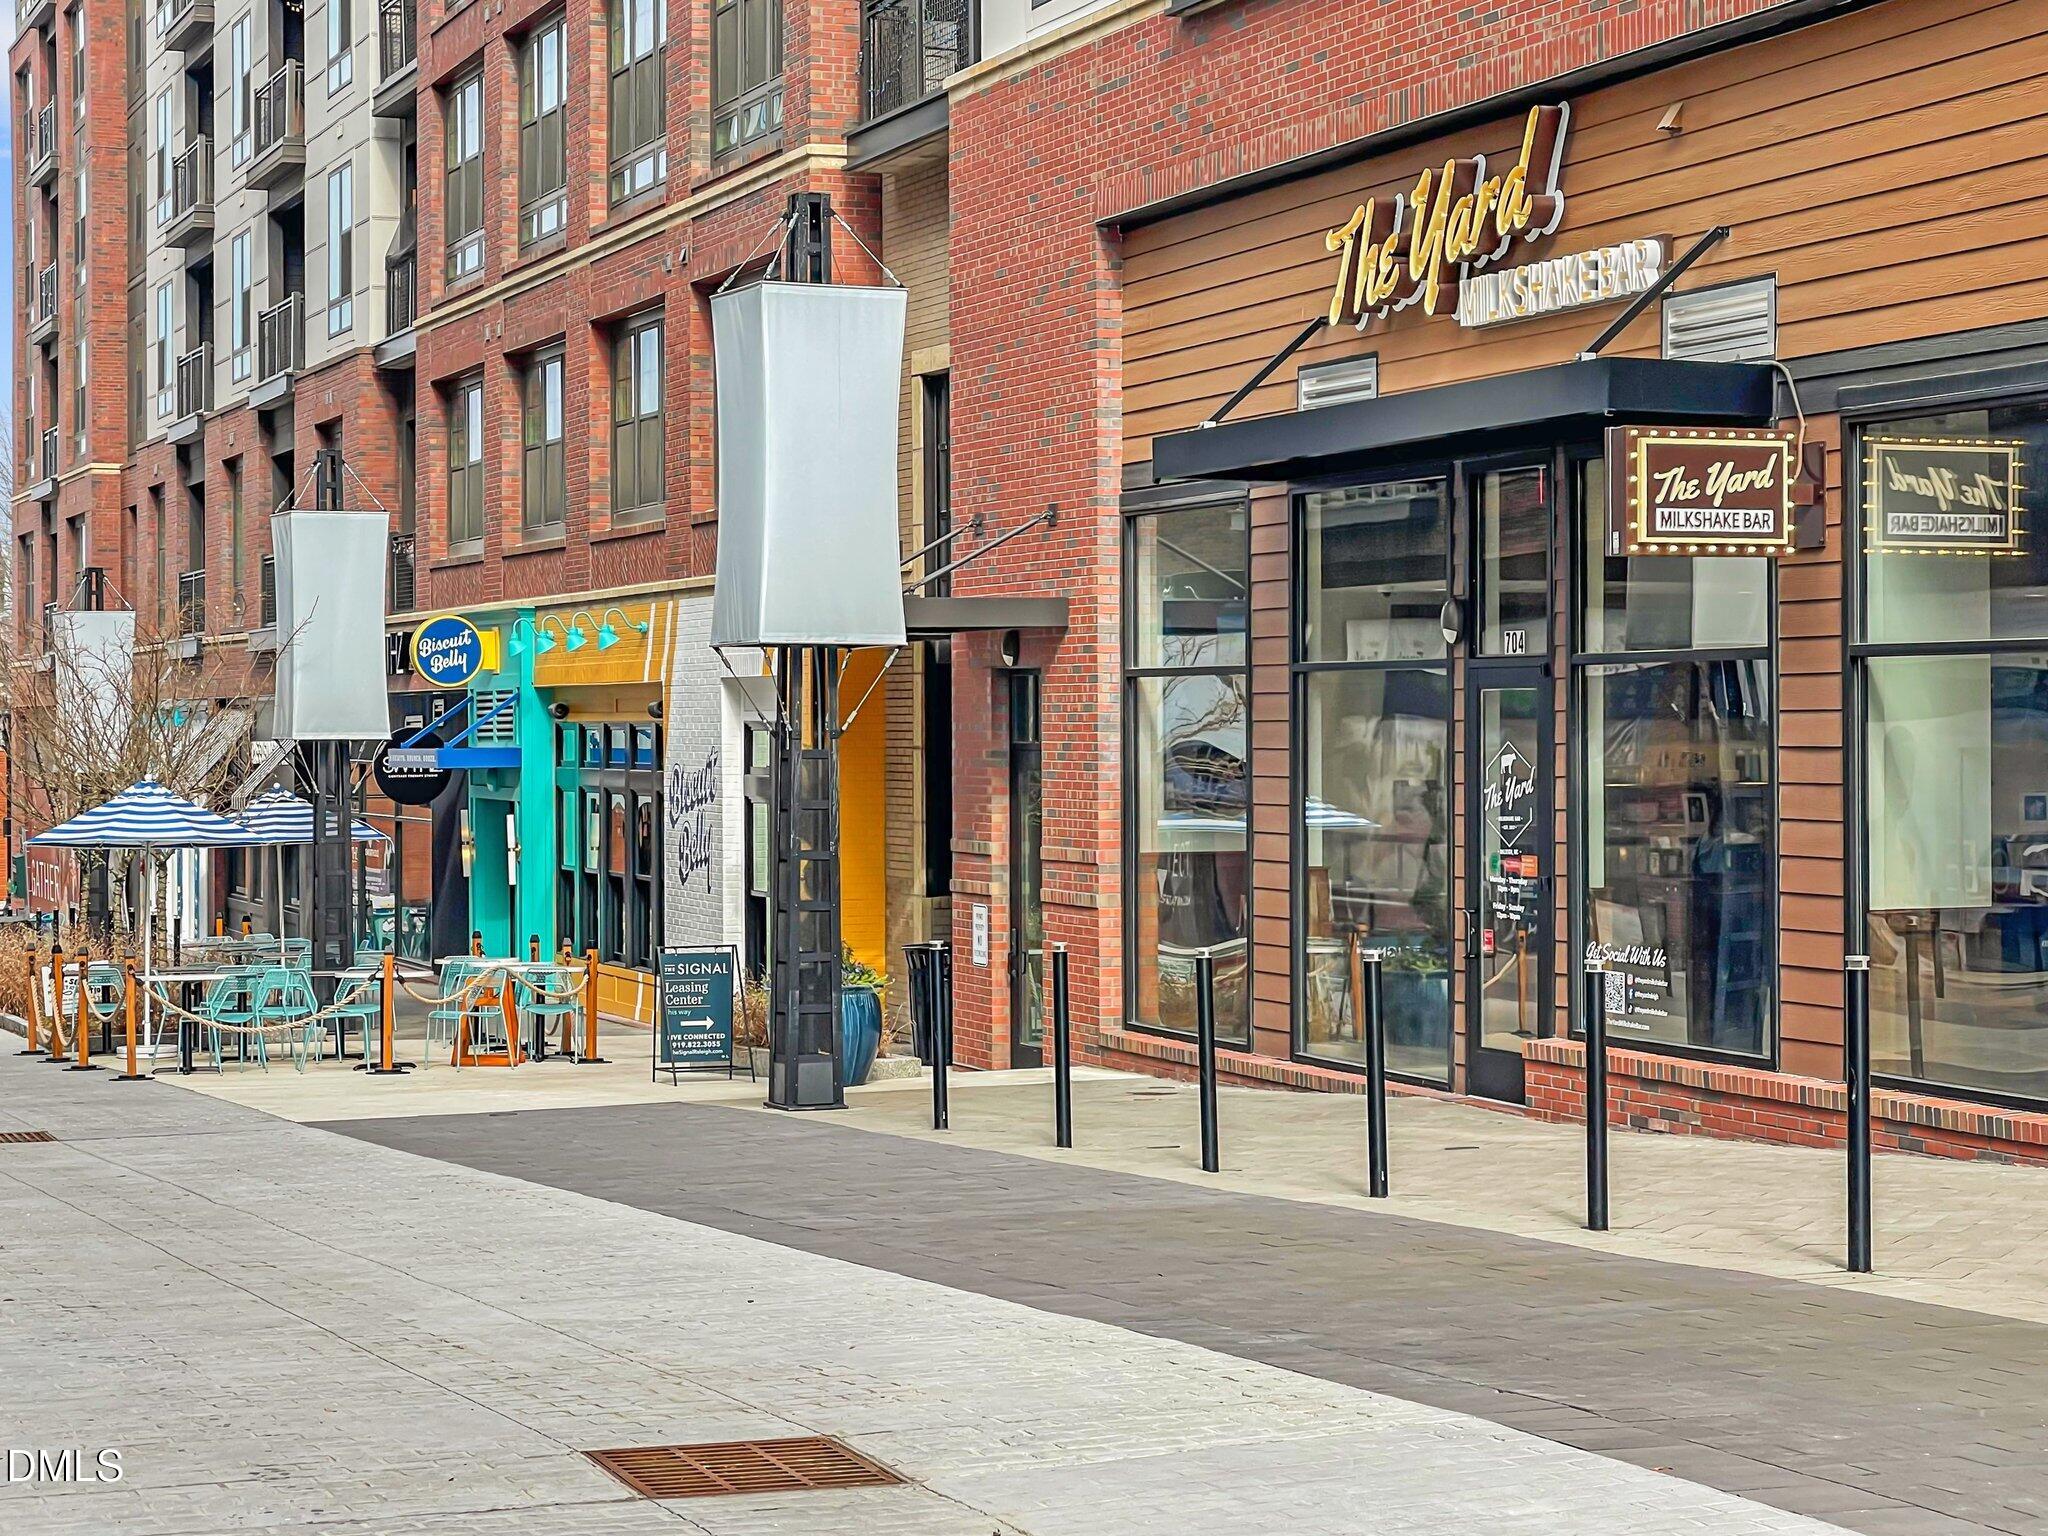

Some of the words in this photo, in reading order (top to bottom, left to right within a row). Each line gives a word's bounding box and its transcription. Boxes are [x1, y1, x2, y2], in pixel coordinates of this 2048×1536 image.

[1326, 197, 1400, 326] The
[1410, 104, 1545, 317] Yard
[1459, 251, 1598, 327] MILKSHAKE
[1598, 239, 1660, 298] BAR
[1653, 465, 1701, 505] The
[1705, 452, 1778, 508] Yard
[1660, 511, 1740, 530] MILKSHAKE
[1743, 512, 1771, 530] BAR
[419, 628, 473, 658] Biscuit
[1505, 631, 1524, 654] 704
[430, 648, 468, 674] Belly
[669, 745, 719, 829] Biscuit
[1484, 782, 1503, 811] The
[1505, 765, 1536, 811] Yard
[679, 808, 713, 895] Belly
[31, 859, 60, 903] GATHER
[1586, 940, 1602, 960] Get
[1602, 943, 1631, 964] Social
[1630, 945, 1652, 966] With
[1652, 947, 1667, 968] Us
[677, 963, 728, 975] SIGNAL
[664, 982, 709, 995] Leasing
[665, 994, 704, 1006] Center
[678, 1009, 692, 1017] way
[672, 1040, 721, 1049] 919.822.3055
[672, 1049, 724, 1057] heSignalRaleigh.com
